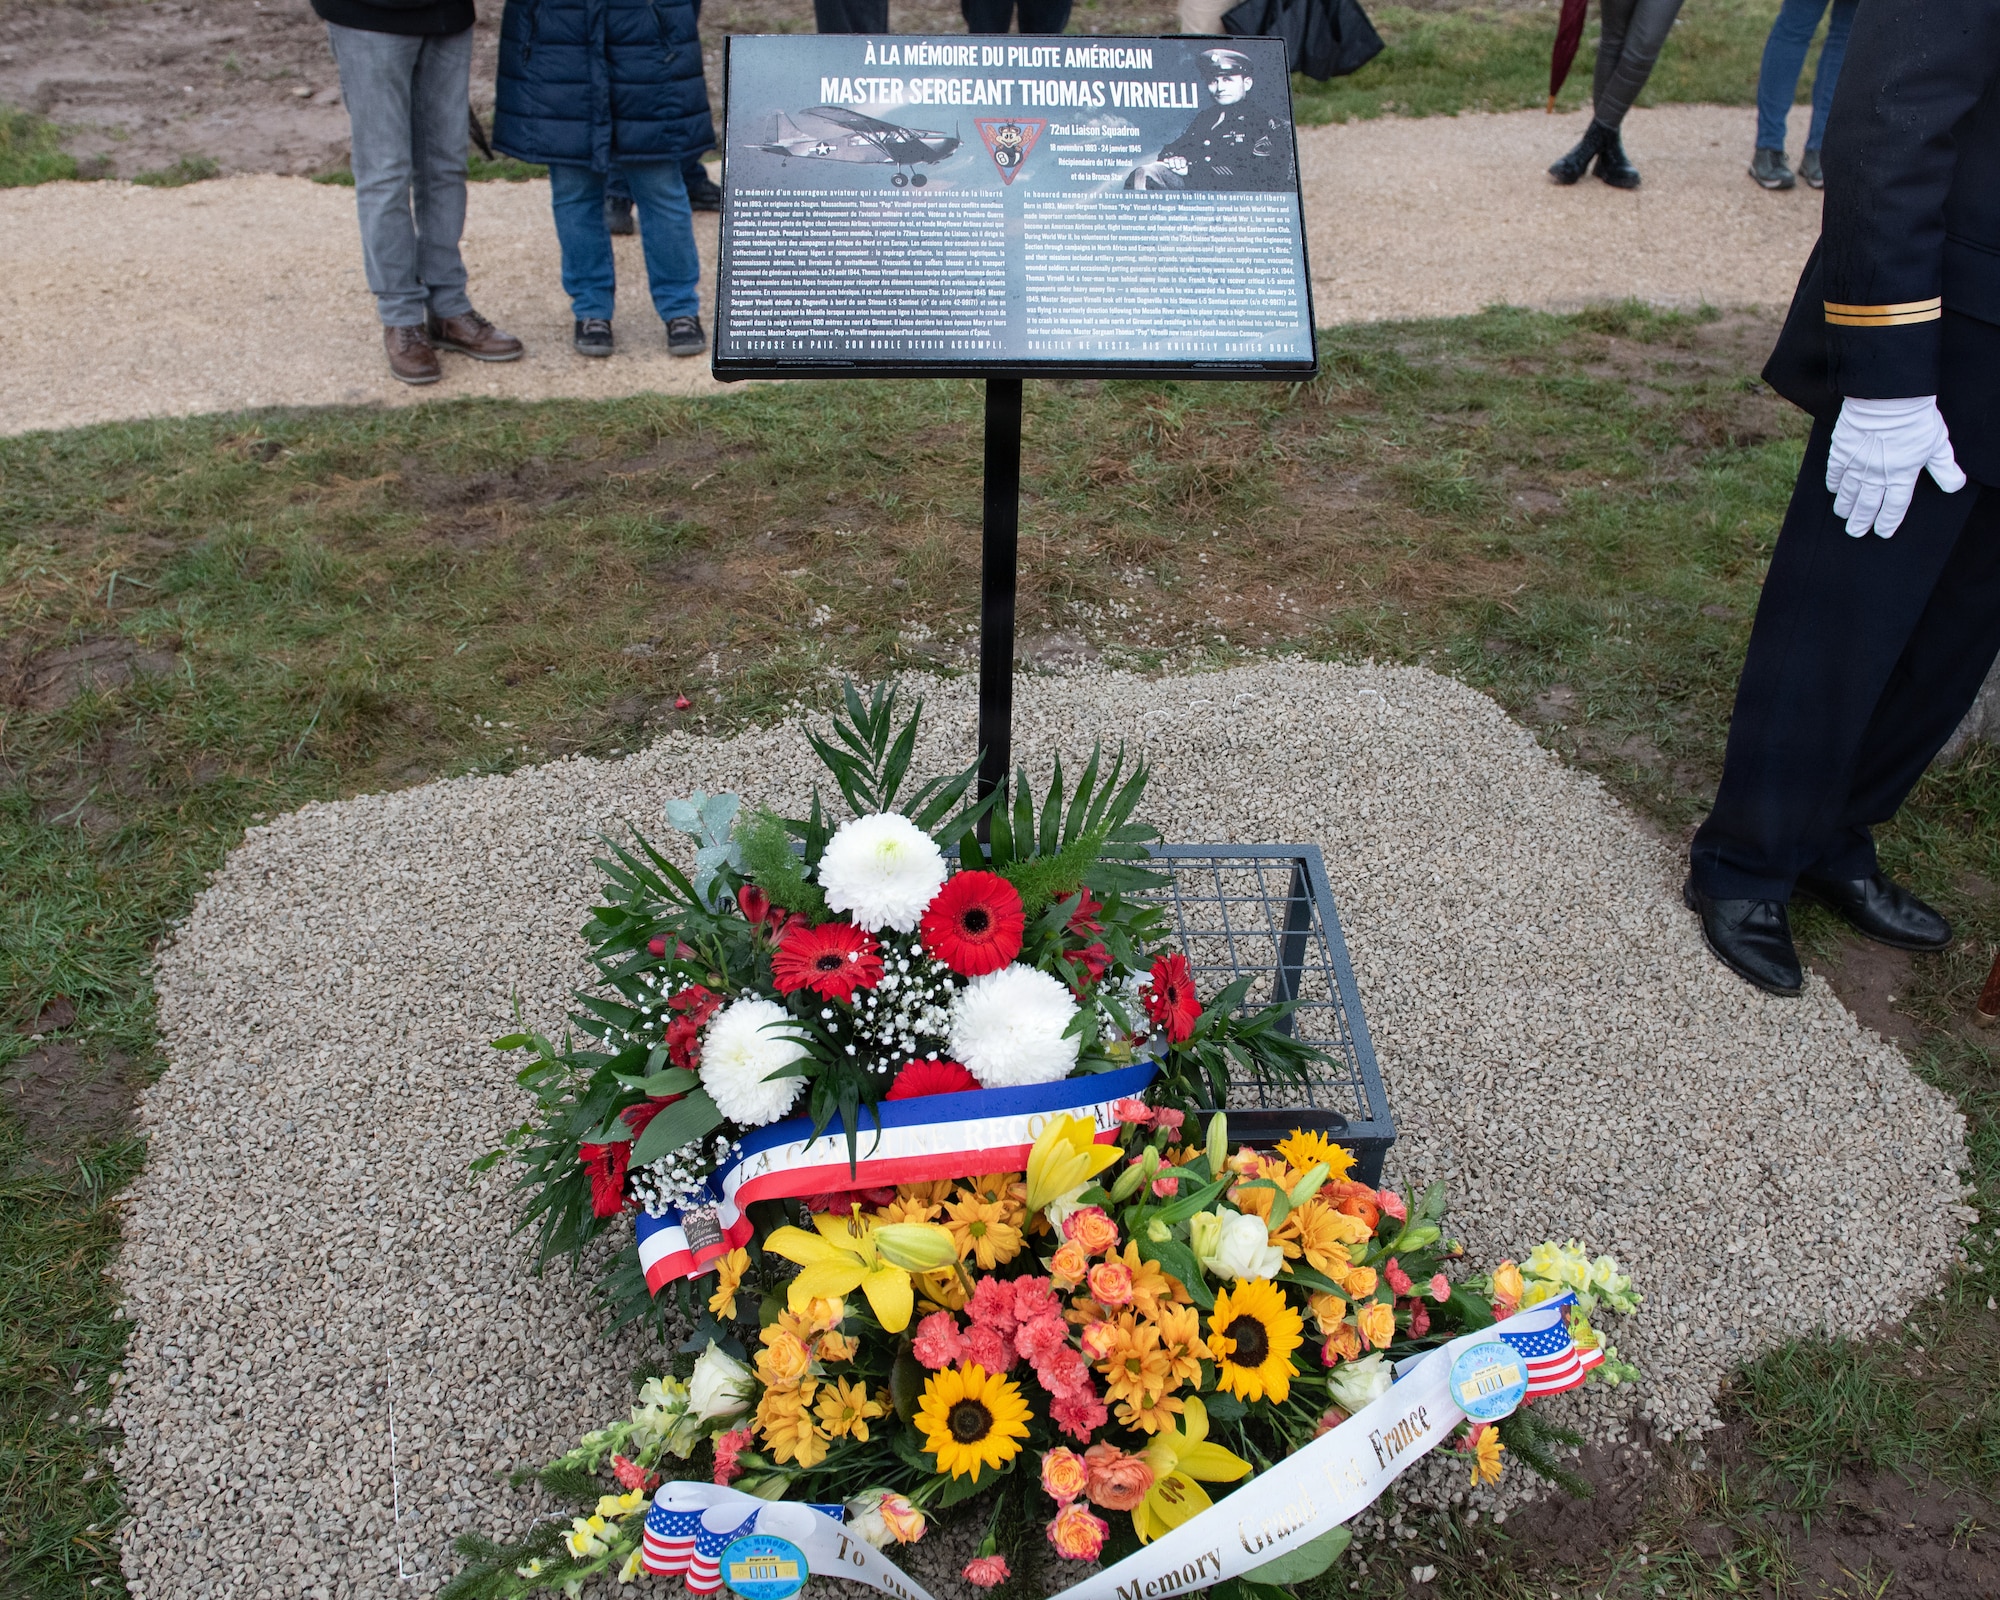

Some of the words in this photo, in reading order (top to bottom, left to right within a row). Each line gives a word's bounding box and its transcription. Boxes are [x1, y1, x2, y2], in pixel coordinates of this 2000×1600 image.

[865, 40, 876, 65] À
[880, 46, 900, 66] LA
[904, 42, 978, 67] MÉMOIRE
[982, 47, 1004, 67] DU
[1008, 47, 1061, 68] PILOTE
[1064, 44, 1153, 70] AMÉRICAIN
[820, 77, 905, 104] MASTER
[909, 78, 1015, 106] SERGEANT
[1018, 79, 1105, 107] THOMAS
[1108, 82, 1199, 109] VIRNELLI
[1049, 124, 1070, 136] 72nd
[1072, 124, 1100, 136] Liaison
[1102, 125, 1140, 138] Squadron
[1057, 144, 1083, 152] novembre
[1109, 145, 1127, 154] janvier
[1129, 145, 1142, 153] 1945
[1116, 159, 1132, 167] Medal
[860, 189, 871, 198] qui
[873, 189, 877, 197] a
[902, 189, 909, 197] sa
[912, 189, 922, 197] vie
[924, 189, 932, 197] au
[961, 189, 969, 197] de
[971, 189, 978, 197] la
[1150, 192, 1163, 200] who
[1216, 193, 1227, 201] the
[1255, 193, 1262, 201] of
[730, 340, 740, 350] IL
[747, 340, 784, 350] REPOSE
[792, 340, 803, 350] EN
[810, 340, 838, 350] PAIX.
[845, 340, 863, 349] SON
[871, 340, 900, 349] NOBLE
[908, 340, 944, 349] DEVOIR
[1079, 341, 1090, 350] HE
[1142, 342, 1160, 351] HIS
[1116, 1547, 1220, 1600] Memory
[1238, 1482, 1319, 1555] Grand
[1368, 1404, 1432, 1472] France
[836, 1532, 865, 1566] To
